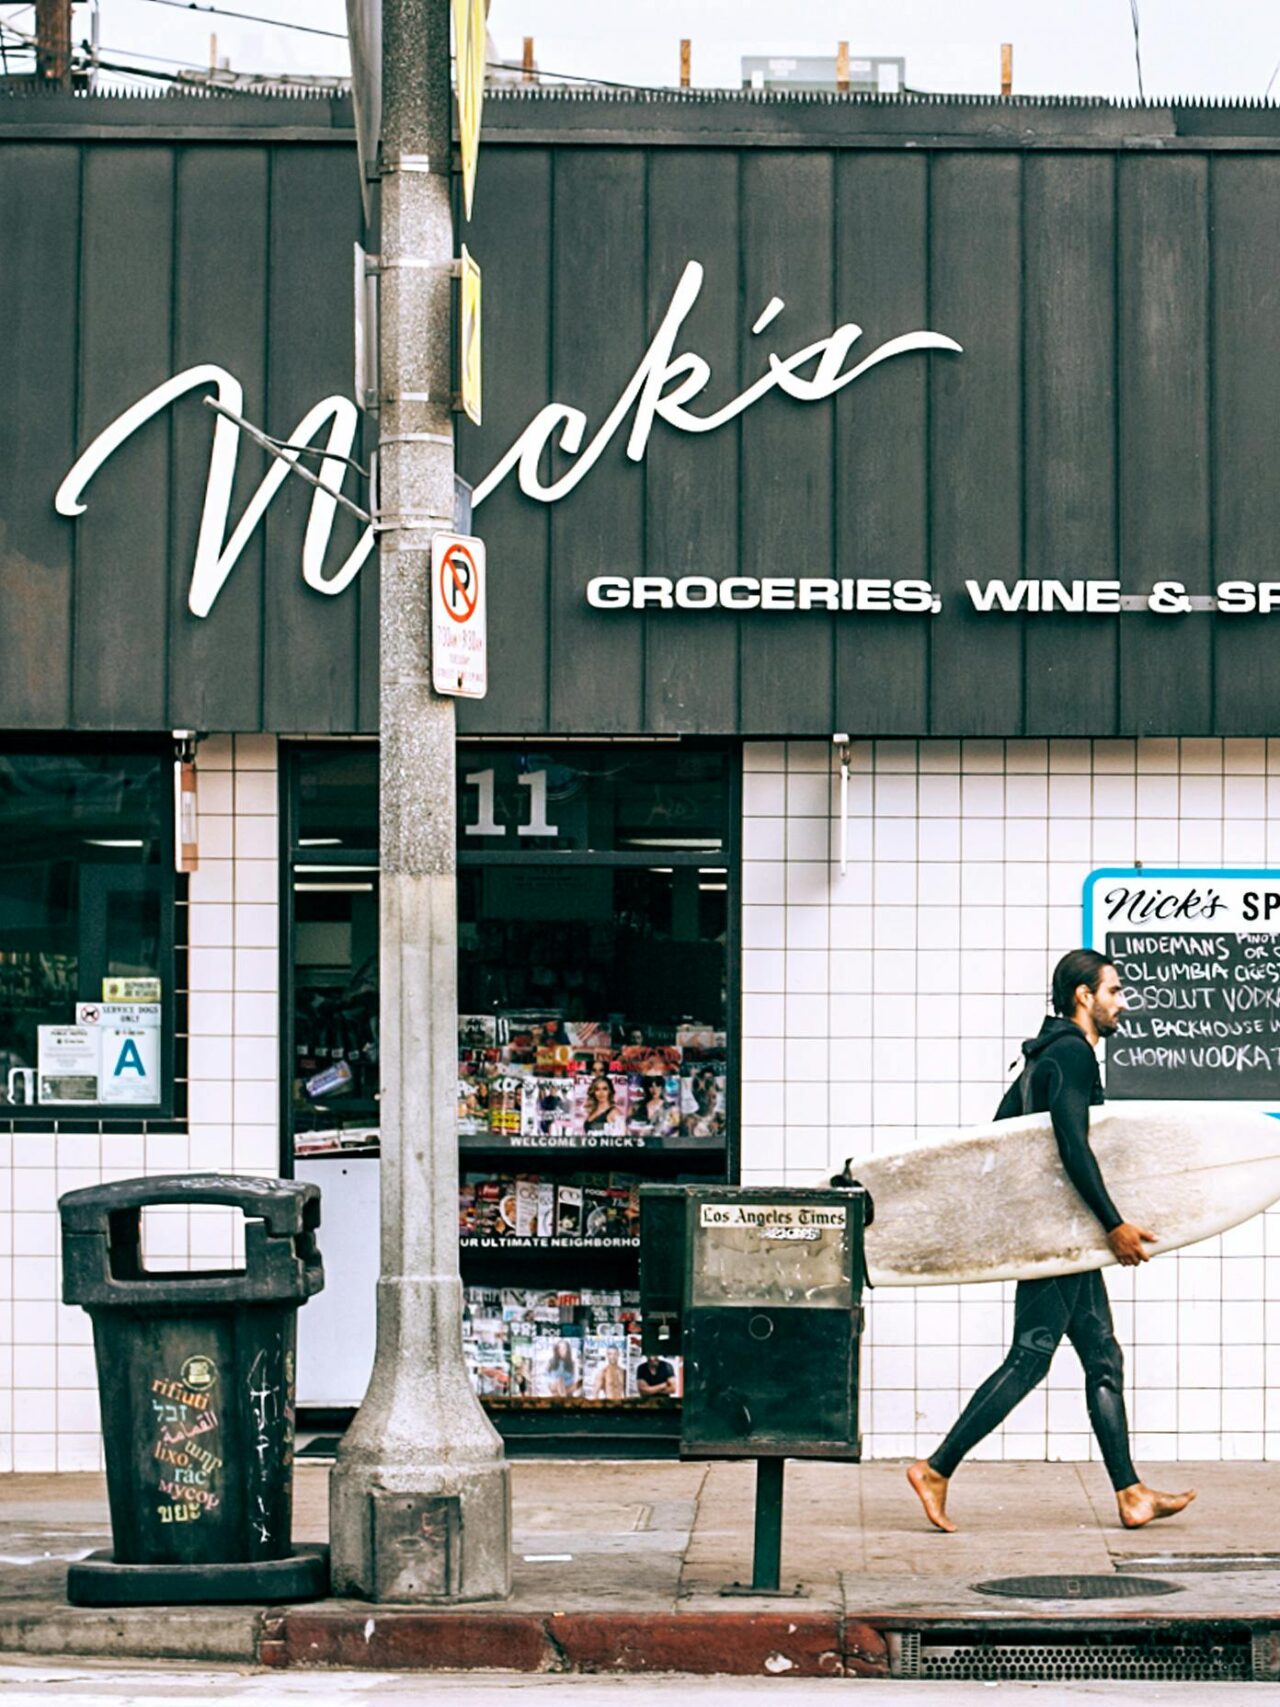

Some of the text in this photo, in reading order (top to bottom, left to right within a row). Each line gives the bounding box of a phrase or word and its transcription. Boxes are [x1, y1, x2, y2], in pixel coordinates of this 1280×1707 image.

[55, 260, 963, 618] Nck's
[586, 575, 942, 614] GROCERIES,
[965, 578, 1121, 613] WINE
[1148, 580, 1192, 613] &
[465, 768, 558, 836] 11
[1105, 887, 1228, 925] Nick's
[1110, 936, 1230, 960] LINDEMANS
[1236, 933, 1279, 944] PINOT
[1245, 947, 1268, 959] OR
[1120, 985, 1216, 1011] BSOLUT
[1151, 1018, 1263, 1039] BACKHOUSE
[114, 1038, 146, 1077] A
[1113, 1046, 1187, 1069] CHOPIN
[1190, 1044, 1272, 1072] VODKA
[510, 1137, 646, 1148] WELCOME TO NICK'S
[703, 1207, 846, 1227] Los Angeles Times
[460, 1237, 641, 1248] UR ULTIMATE NEIGHBORHO
[151, 1377, 211, 1411] rifiuti
[152, 1399, 188, 1422] זבל
[153, 1441, 190, 1467] lixo
[173, 1464, 207, 1485] rác
[157, 1501, 201, 1523] ขยะ
